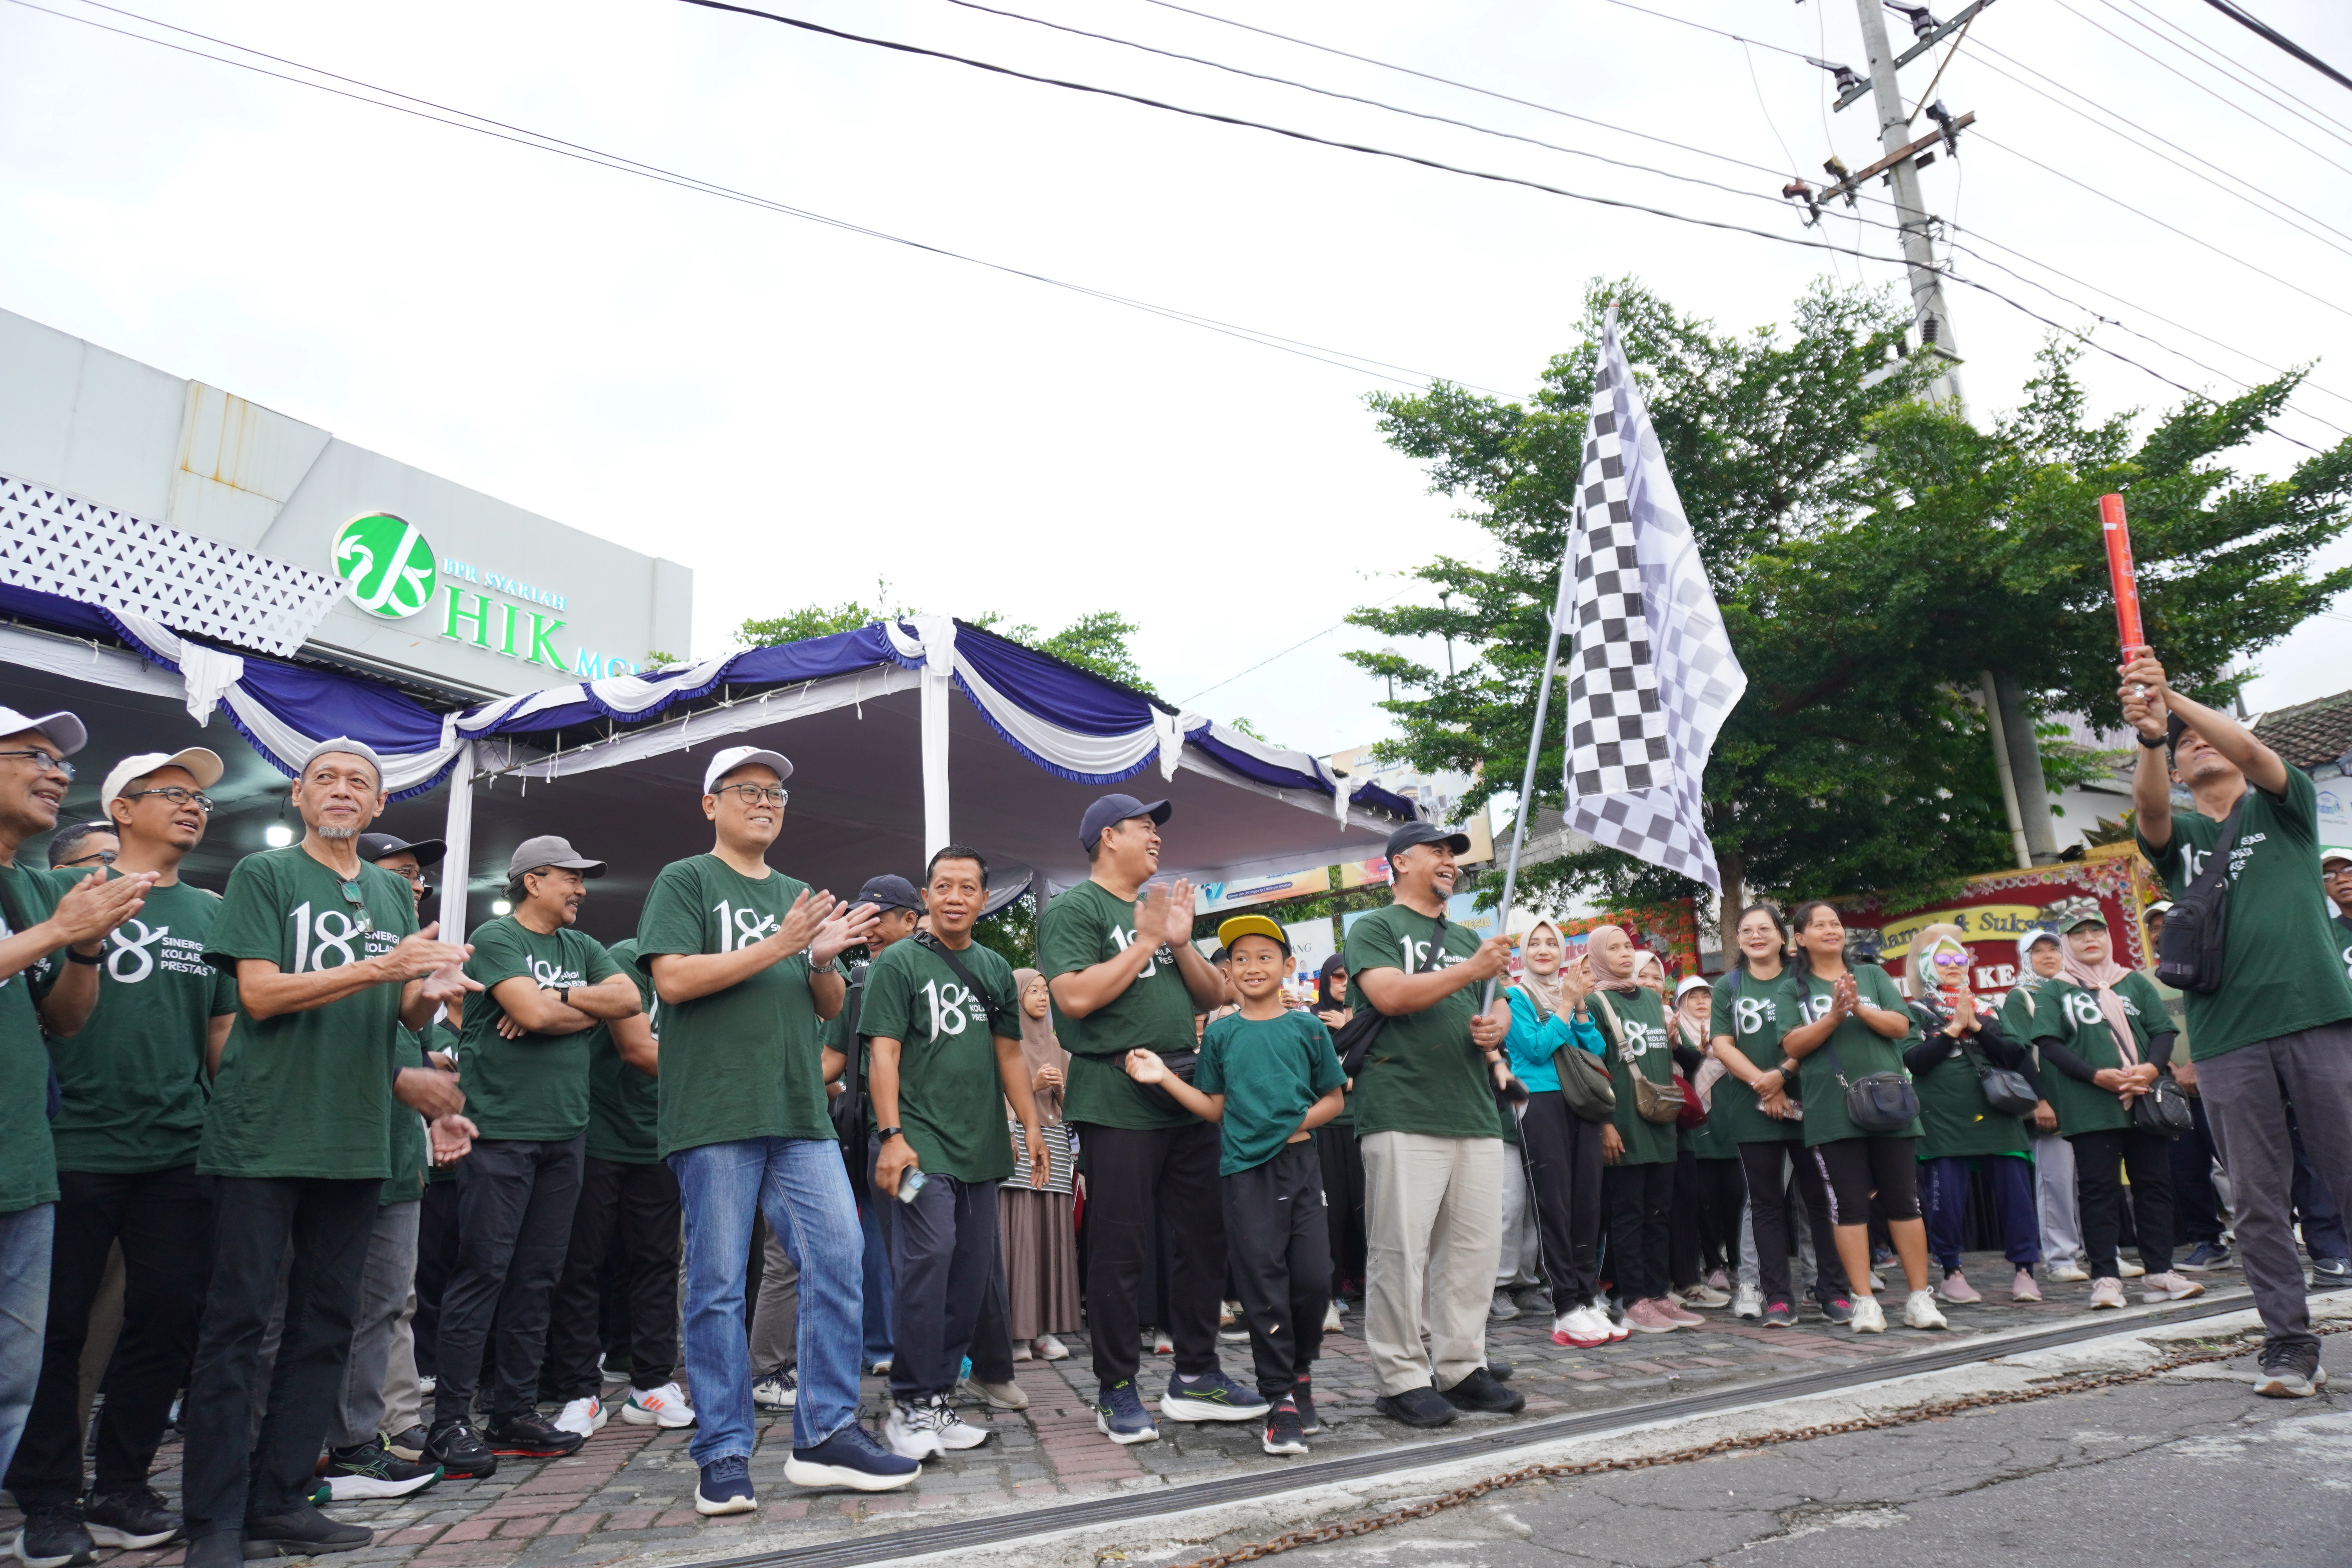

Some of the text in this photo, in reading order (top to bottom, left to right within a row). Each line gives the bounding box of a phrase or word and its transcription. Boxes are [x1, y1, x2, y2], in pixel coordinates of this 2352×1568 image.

[443, 558, 567, 612] BPR SYARIAH
[438, 584, 570, 672] HIK
[161, 949, 206, 964] KOLAB
[162, 936, 204, 951] SINERG
[920, 979, 969, 1044] 18
[2063, 993, 2103, 1034] 18
